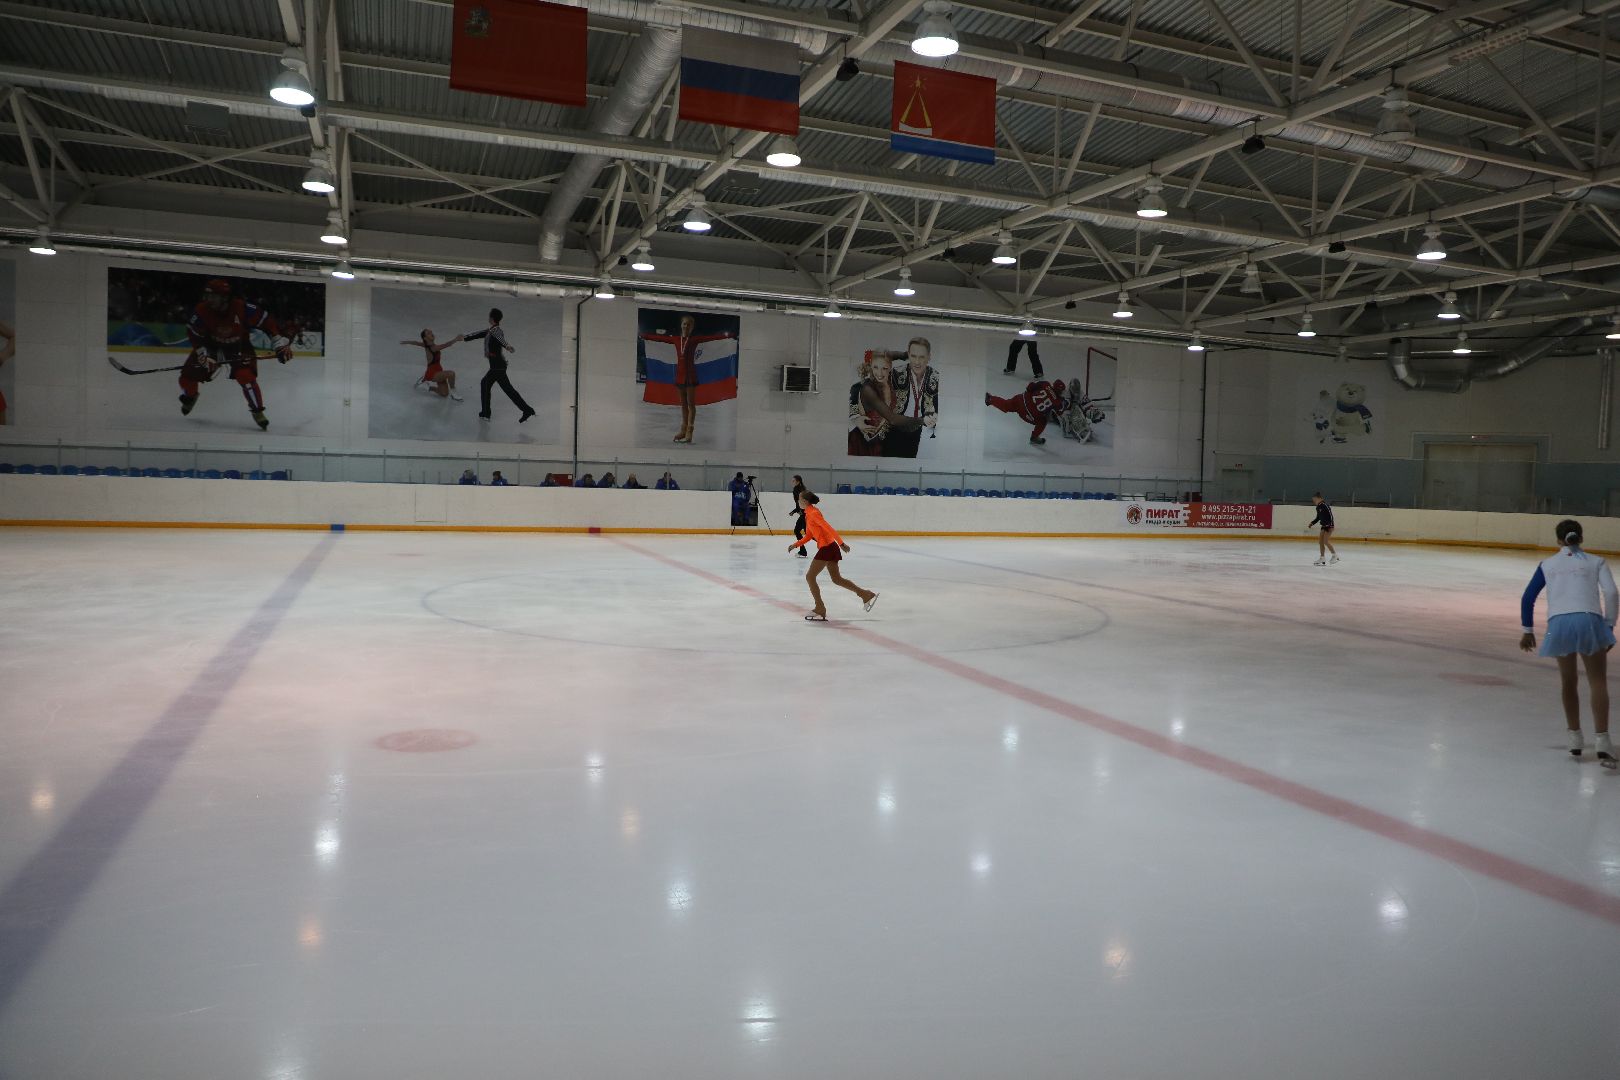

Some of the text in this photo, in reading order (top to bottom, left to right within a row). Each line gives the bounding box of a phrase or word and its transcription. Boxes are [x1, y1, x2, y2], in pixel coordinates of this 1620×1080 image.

[1032, 390, 1052, 411] 28
[1146, 508, 1180, 518] ПИРАТ
[1201, 504, 1256, 514] 8 495 215-21-21
[1201, 513, 1256, 521] www.pizzapirat.ru
